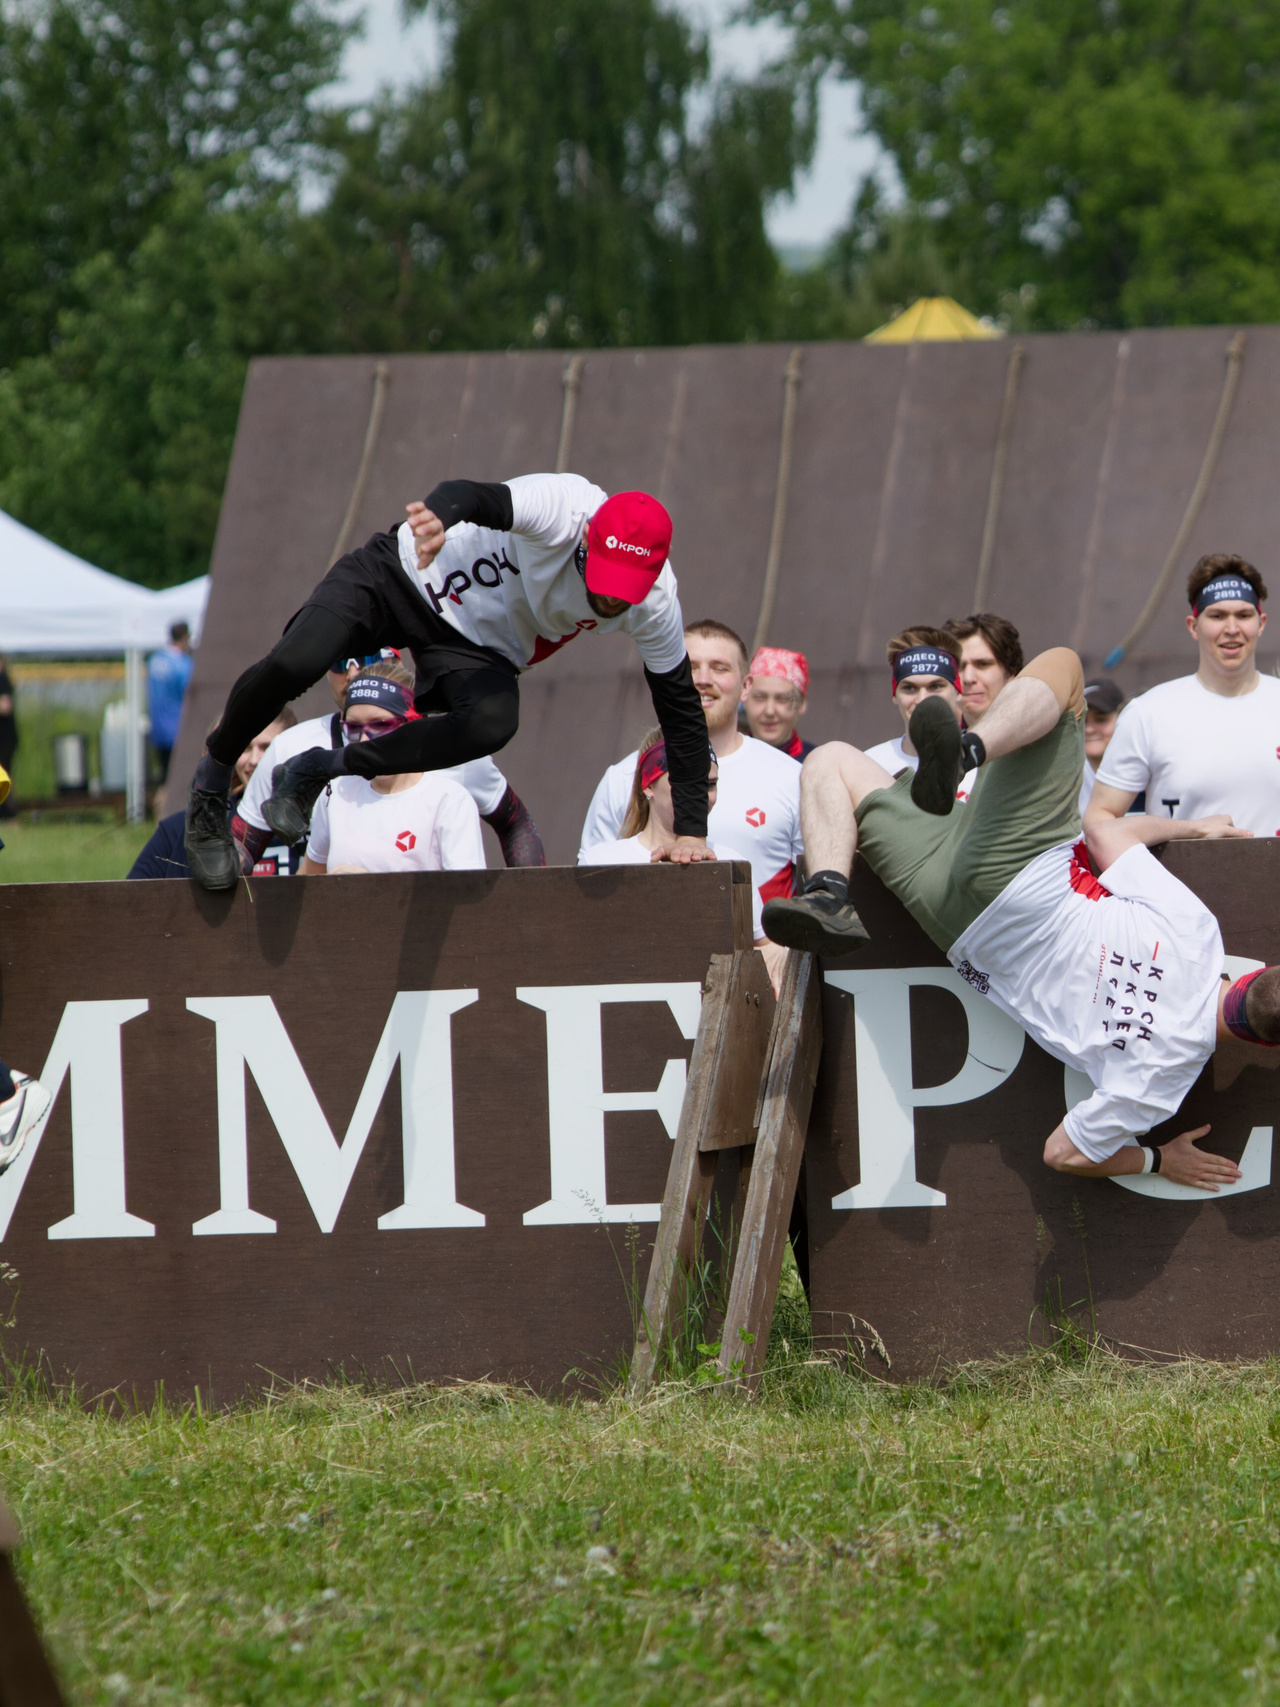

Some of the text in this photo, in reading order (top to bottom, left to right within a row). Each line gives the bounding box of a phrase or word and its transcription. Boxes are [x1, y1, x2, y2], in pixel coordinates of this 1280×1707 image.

[618, 541, 651, 557] КРОН
[424, 547, 520, 614] КРОН
[1202, 580, 1239, 595] РОДЕО
[1214, 589, 1242, 600] 2891
[900, 652, 950, 666] РОДЕО 59
[911, 663, 939, 673] 2877
[351, 689, 379, 698] 2888
[382, 682, 396, 693] 59
